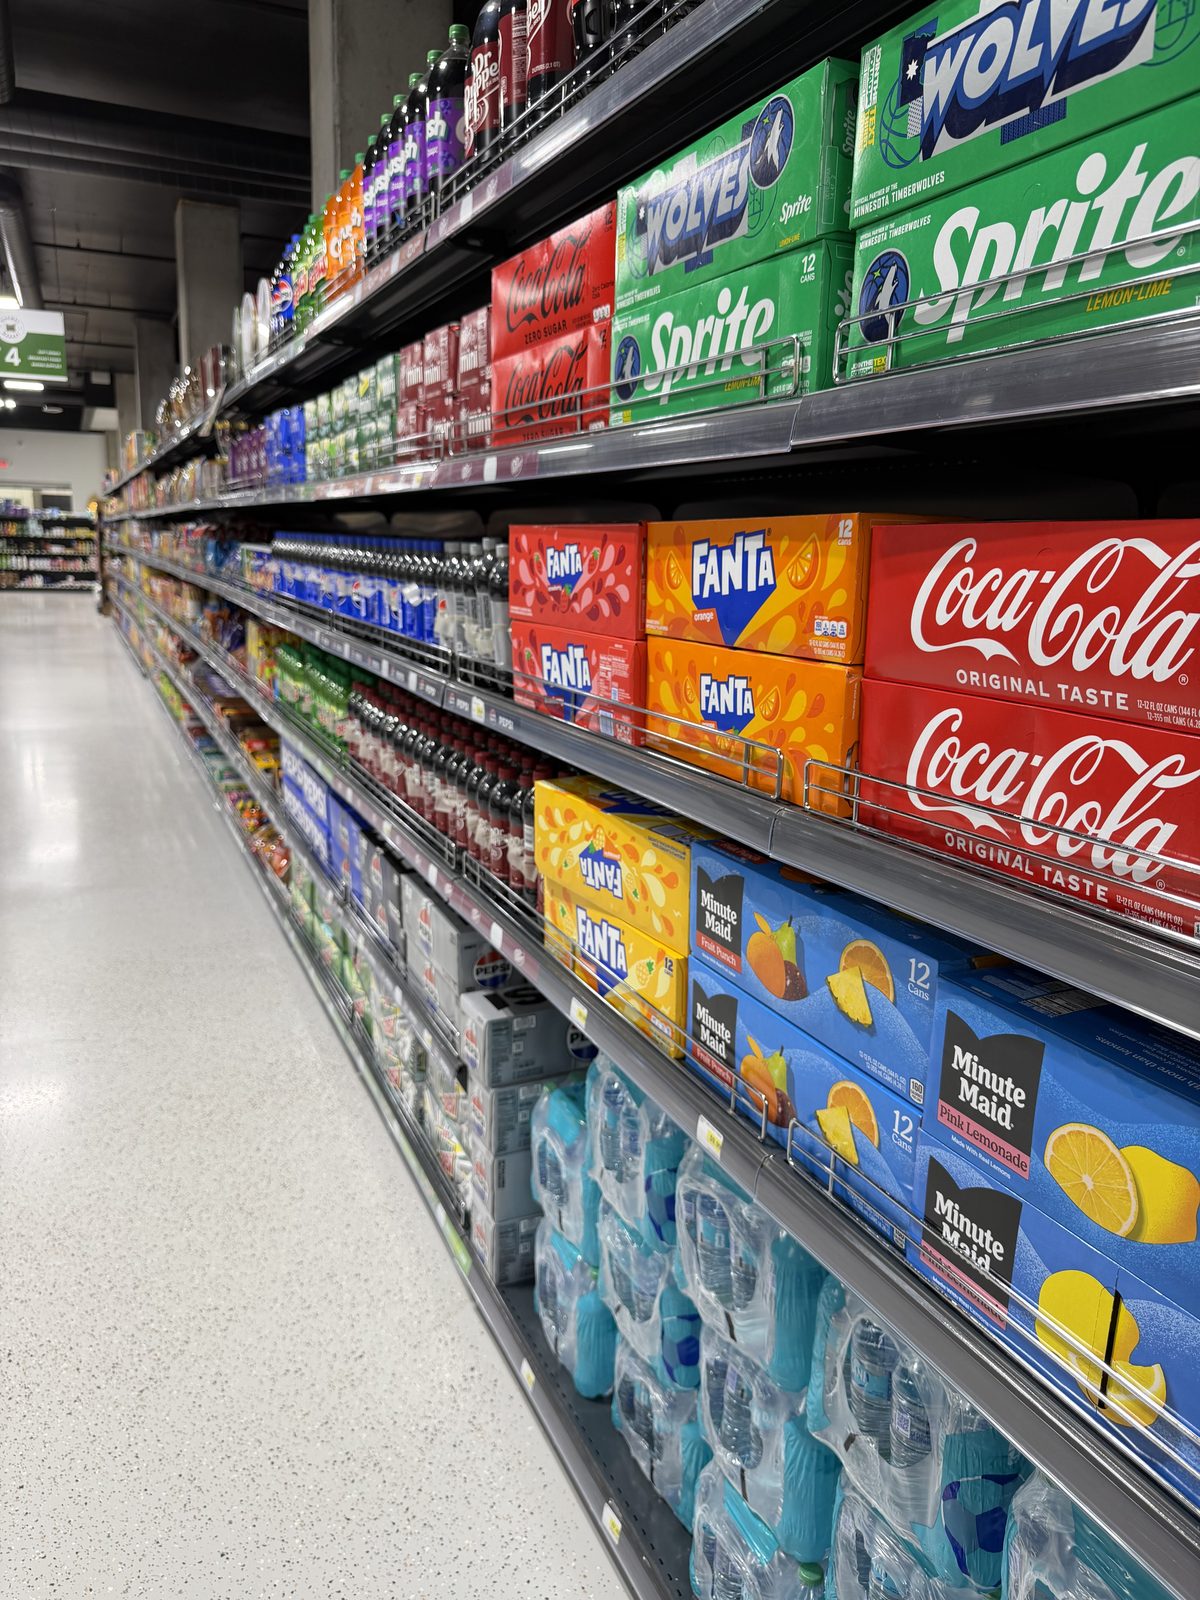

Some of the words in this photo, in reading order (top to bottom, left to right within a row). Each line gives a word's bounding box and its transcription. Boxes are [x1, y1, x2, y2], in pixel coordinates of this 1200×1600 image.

[648, 153, 751, 250] WOLVES
[780, 194, 812, 224] Sprite
[854, 196, 889, 218] MINNESOTA
[891, 171, 945, 203] TIMBERWOLVES
[889, 215, 932, 238] TIMBERWOLVES
[913, 142, 1200, 344] Sprite
[800, 273, 816, 284] CANS
[802, 253, 816, 273] 12
[1086, 278, 1174, 312] LEMON-LIME
[524, 328, 542, 345] ZERO
[543, 320, 568, 338] SUGAR
[644, 286, 775, 405] Sprite
[4, 346, 22, 367] 4
[838, 519, 853, 538] 12
[546, 544, 582, 579] FANTA
[691, 531, 774, 599] FANTA
[694, 610, 714, 622] orange
[910, 537, 1200, 683] Coca-Cola
[541, 645, 591, 689] FANTA
[700, 675, 754, 715] FANTA
[956, 669, 1050, 698] ORIGINAL
[1057, 684, 1129, 711] TASTE
[1147, 712, 1163, 722] 12-355
[1172, 716, 1186, 726] CANS
[1150, 701, 1155, 710] FL
[1156, 702, 1163, 712] OZ
[1164, 704, 1177, 714] CANS
[1179, 705, 1190, 716] (144
[906, 708, 1200, 882] Coca-Cola
[580, 858, 622, 899] FANTA
[944, 832, 1034, 876] ORIGINAL
[1041, 864, 1108, 904] TASTE
[701, 889, 738, 925] Minute
[1141, 904, 1154, 916] CANS
[576, 906, 628, 972] FANTA
[704, 912, 733, 942] Maid
[664, 957, 674, 973] 12
[702, 936, 716, 953] Fruit
[716, 946, 736, 966] Punch
[476, 964, 510, 977] PEPSI
[908, 958, 931, 990] 12
[907, 983, 930, 1001] Cans
[696, 1002, 731, 1044] Minute
[700, 1028, 726, 1060] Maid
[1132, 1053, 1157, 1068] than
[696, 1049, 711, 1065] Fruit
[711, 1061, 732, 1082] Punch
[952, 1044, 1026, 1108] Minute
[912, 1081, 922, 1094] 160
[958, 1077, 1014, 1131] Maid
[892, 1110, 914, 1143] 12
[940, 1104, 964, 1131] Pink
[966, 1118, 1028, 1172] Lemonade
[891, 1133, 912, 1154] Cans
[951, 1134, 964, 1146] Made
[964, 1143, 976, 1154] With
[978, 1151, 989, 1162] Real
[990, 1158, 1011, 1179] Lemons
[934, 1190, 1005, 1262] Minute
